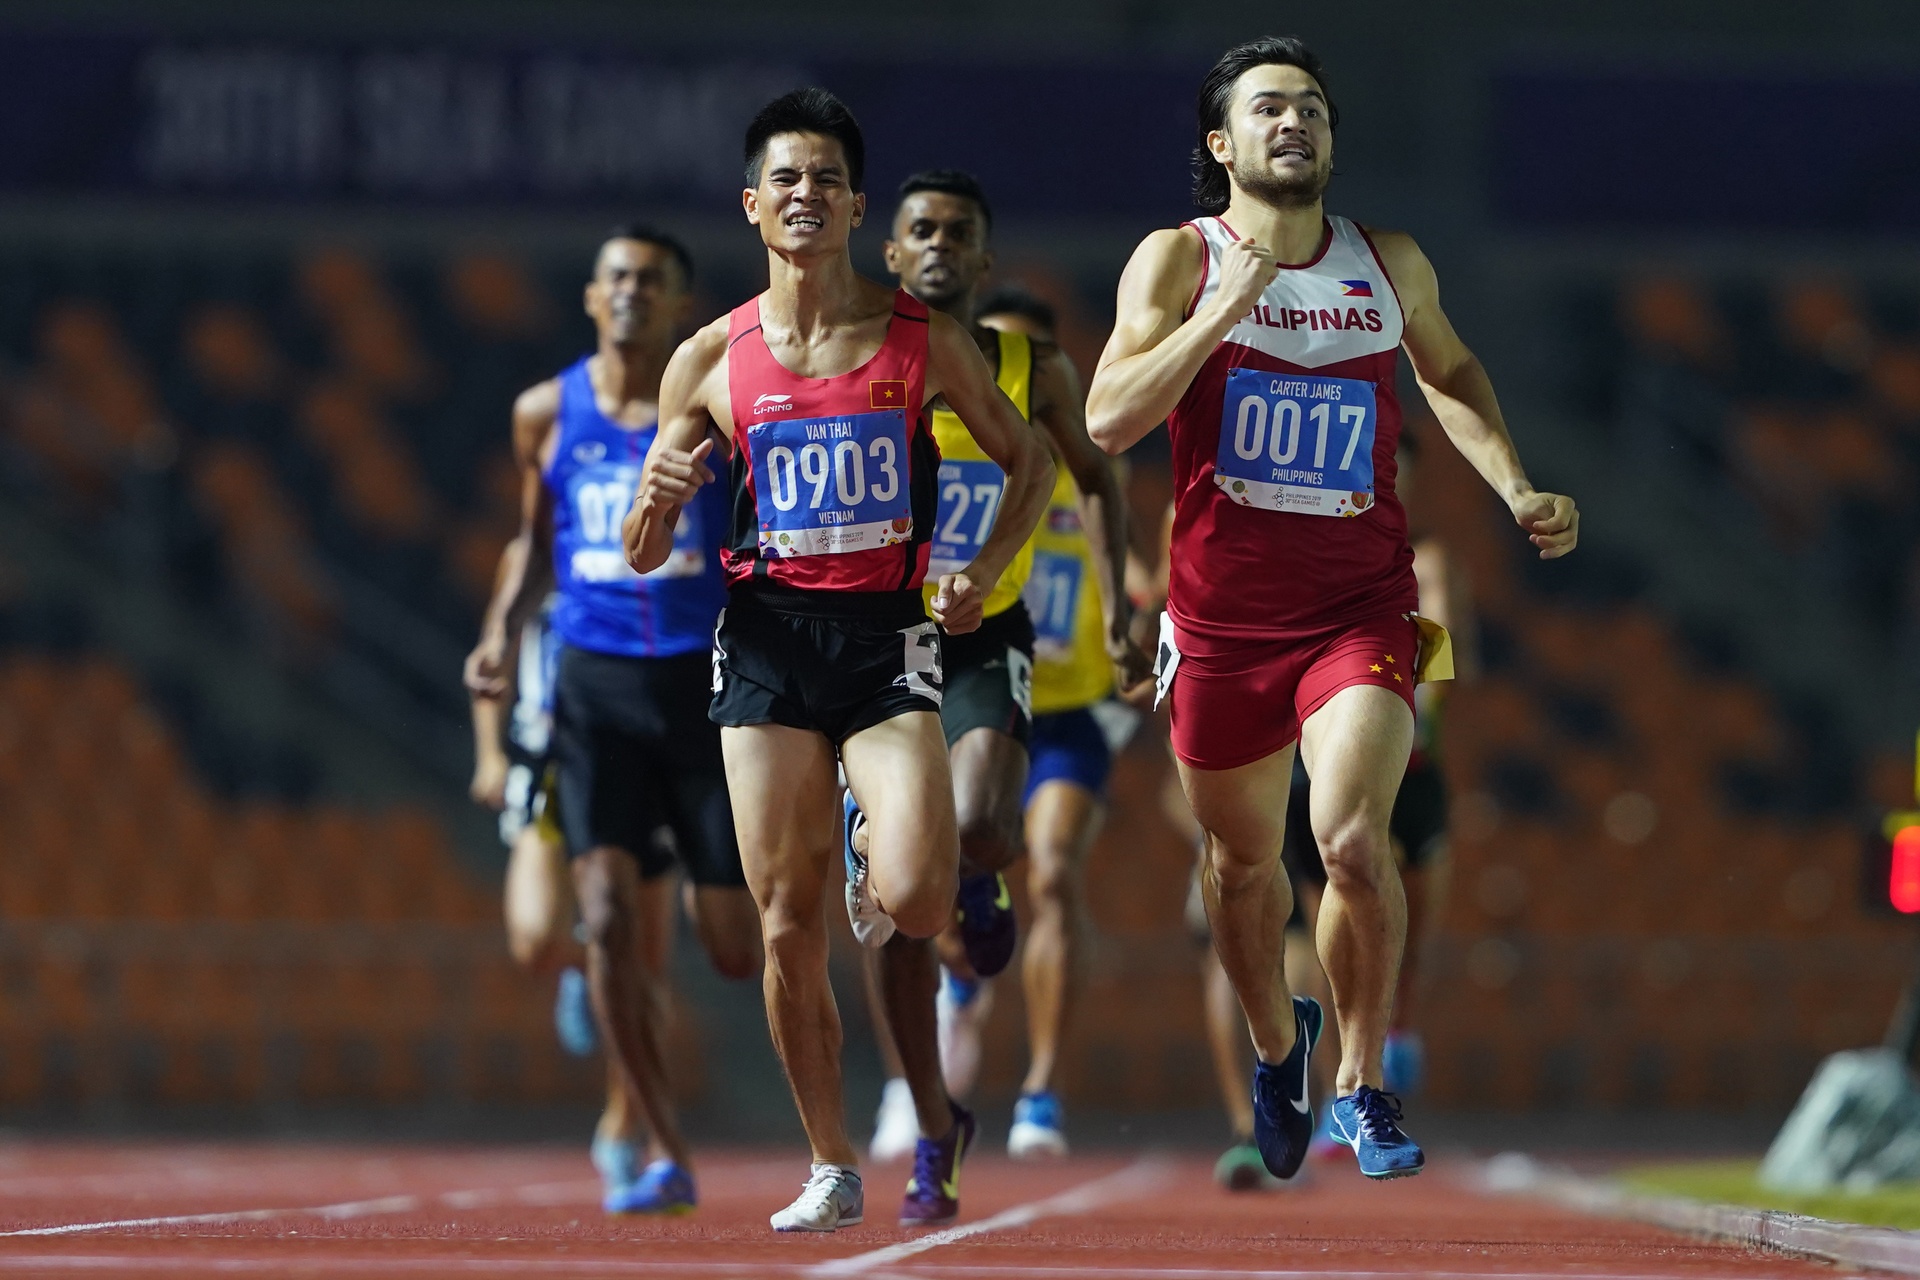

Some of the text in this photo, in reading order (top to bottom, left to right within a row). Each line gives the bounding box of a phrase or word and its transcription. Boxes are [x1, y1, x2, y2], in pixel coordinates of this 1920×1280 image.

[1269, 379, 1342, 401] CARTER JAMES
[753, 403, 793, 415] LI-NING
[805, 421, 852, 441] VAN THAI
[1233, 394, 1366, 471] 0017
[766, 436, 899, 512] 0903
[1271, 467, 1324, 485] PHILIPPINES
[818, 509, 855, 525] VIETNAM
[939, 481, 1002, 546] 27
